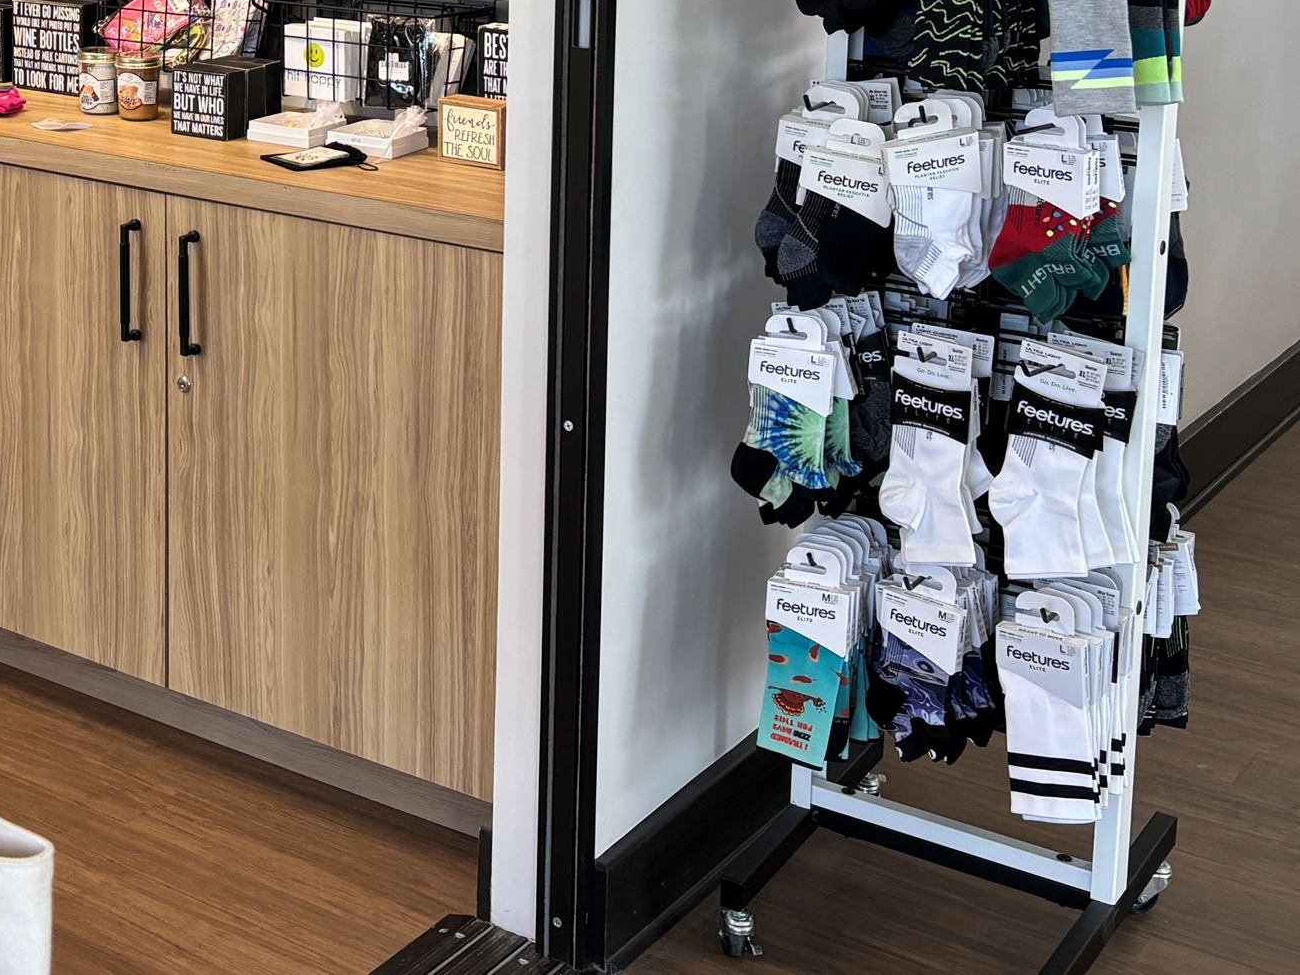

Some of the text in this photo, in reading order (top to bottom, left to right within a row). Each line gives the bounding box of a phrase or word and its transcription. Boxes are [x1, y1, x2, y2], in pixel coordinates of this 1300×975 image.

[13, 2, 18, 14] IF
[25, 3, 40, 17] EVER
[42, 5, 51, 18] GO
[53, 6, 79, 21] MISSING
[32, 18, 40, 27] LIKE
[14, 26, 79, 52] WINE BOTTLES
[484, 32, 508, 59] BES
[14, 47, 77, 65] INSTEAD OF MILK CARTONS
[484, 60, 497, 75] ARE
[14, 68, 78, 93] TO LOOK FOR ME
[174, 71, 224, 86] IT'S NOT WHAT
[484, 77, 501, 92] THAT
[174, 82, 208, 95] WE HAVE IN
[174, 93, 224, 115] BUT WHO
[174, 111, 181, 119] WE
[182, 112, 193, 120] HAVE
[201, 114, 210, 122] OUR
[211, 116, 224, 124] LIVES
[446, 109, 495, 131] friends
[173, 120, 223, 136] THAT MATTERS
[455, 129, 494, 145] REFRESH
[444, 142, 494, 162] THE SOUL
[1061, 154, 1067, 162] L
[907, 155, 965, 174] feetures
[1014, 161, 1072, 181] feetures
[818, 171, 878, 192] feetures
[811, 355, 816, 363] L
[760, 361, 820, 380] feetures
[895, 389, 962, 419] feetures
[1017, 400, 1093, 435] feetures
[822, 593, 830, 602] M
[777, 598, 835, 619] feetures
[938, 610, 946, 620] M
[890, 609, 946, 637] feetures
[909, 629, 924, 637] ELITE
[1007, 646, 1069, 670] feetures
[1060, 645, 1066, 653] L
